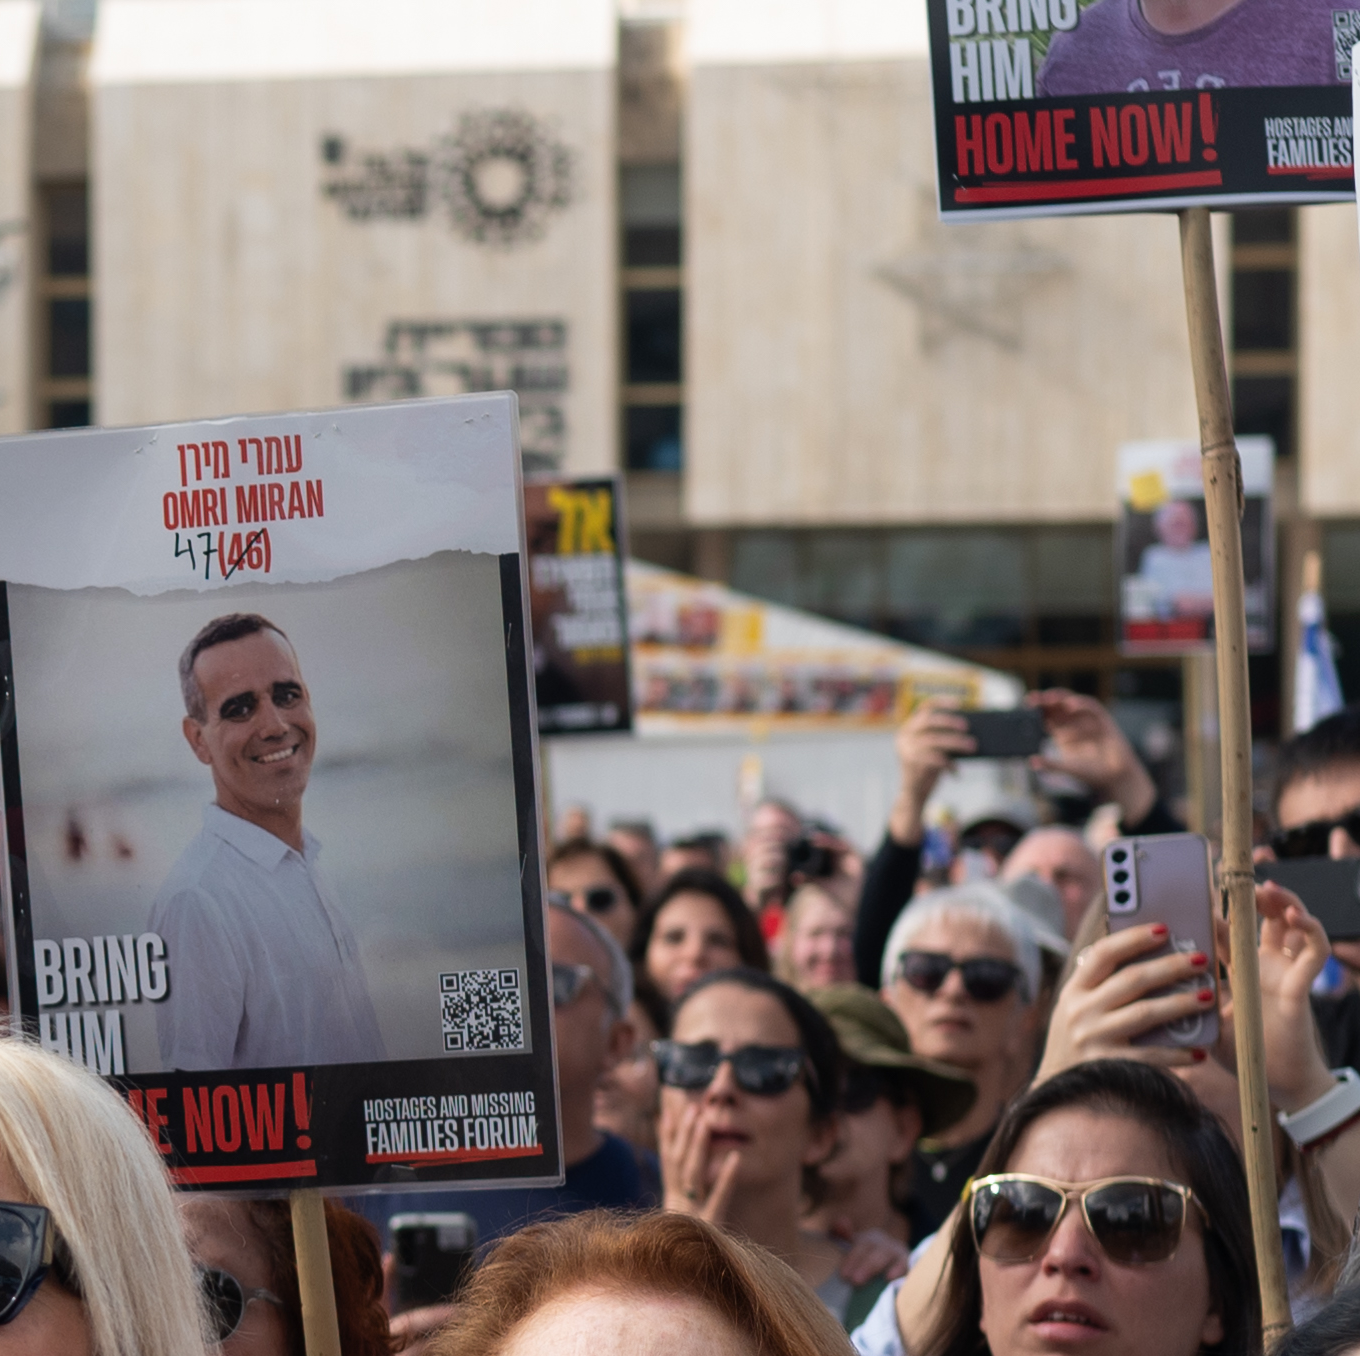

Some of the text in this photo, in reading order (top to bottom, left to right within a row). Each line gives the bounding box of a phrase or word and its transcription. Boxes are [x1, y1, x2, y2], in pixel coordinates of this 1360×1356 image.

[949, 38, 1035, 104] HIM
[954, 92, 1221, 177] HOME NOW!
[1264, 116, 1354, 139] HOSTAGES AN
[1266, 137, 1353, 169] FAMILIES
[178, 435, 304, 487] עמרי מירן
[162, 479, 325, 530] OMRI MIRAN
[34, 932, 169, 1007] BRING
[182, 1072, 315, 1153] NOW!
[364, 1091, 535, 1122] HOSTAGES AND MISSING
[365, 1113, 538, 1155] FAMILIES FORUM
